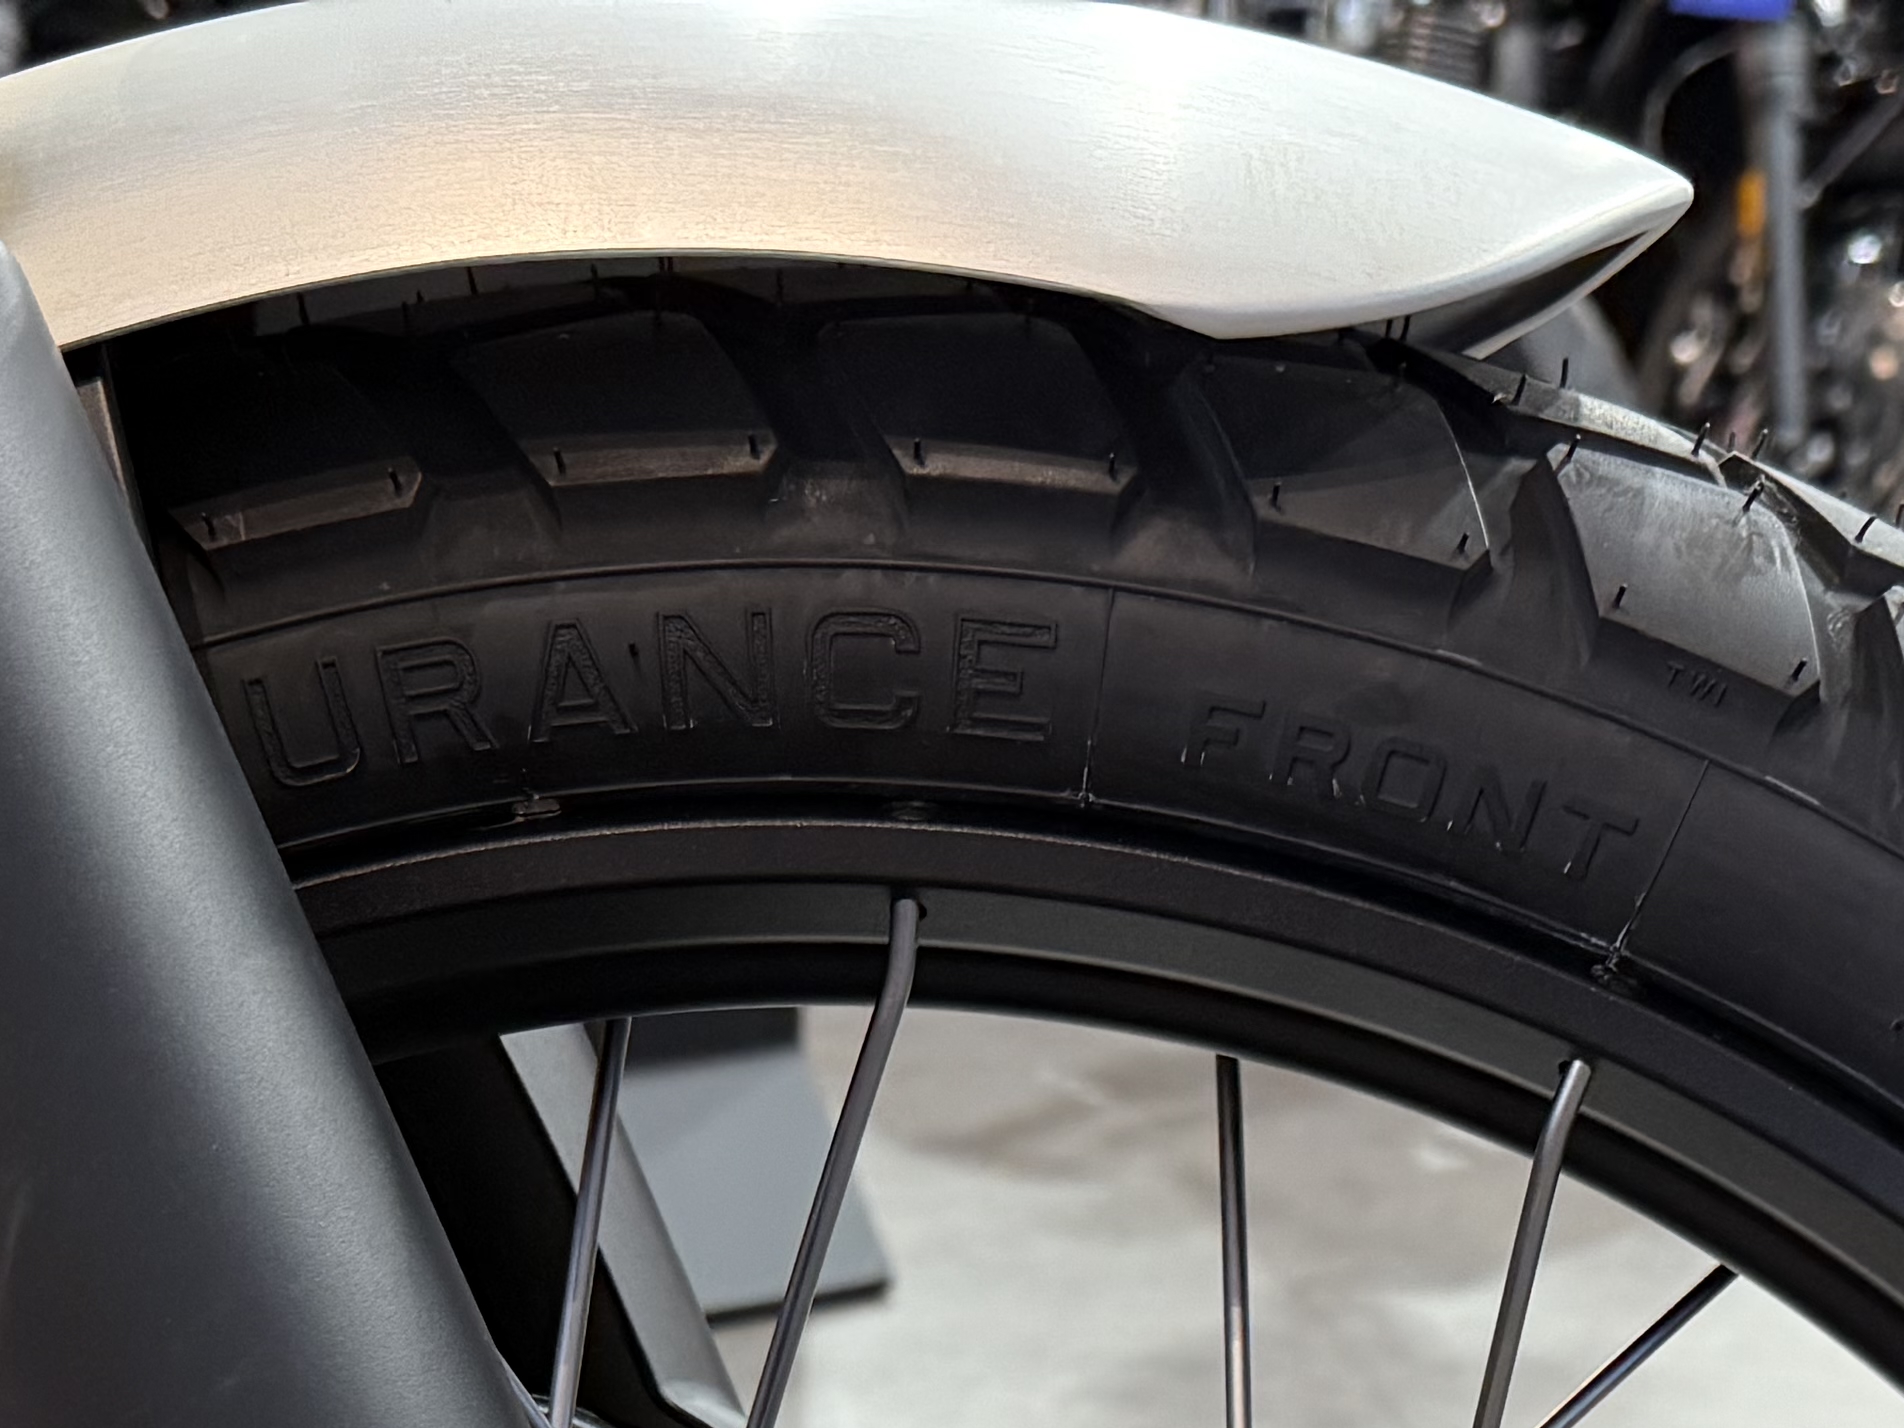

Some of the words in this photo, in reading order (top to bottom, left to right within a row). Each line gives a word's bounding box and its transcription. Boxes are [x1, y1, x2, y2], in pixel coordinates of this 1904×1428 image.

[241, 608, 1059, 786] URANCE
[1180, 700, 1639, 880] FRONT
[1664, 660, 1729, 709] TWI
